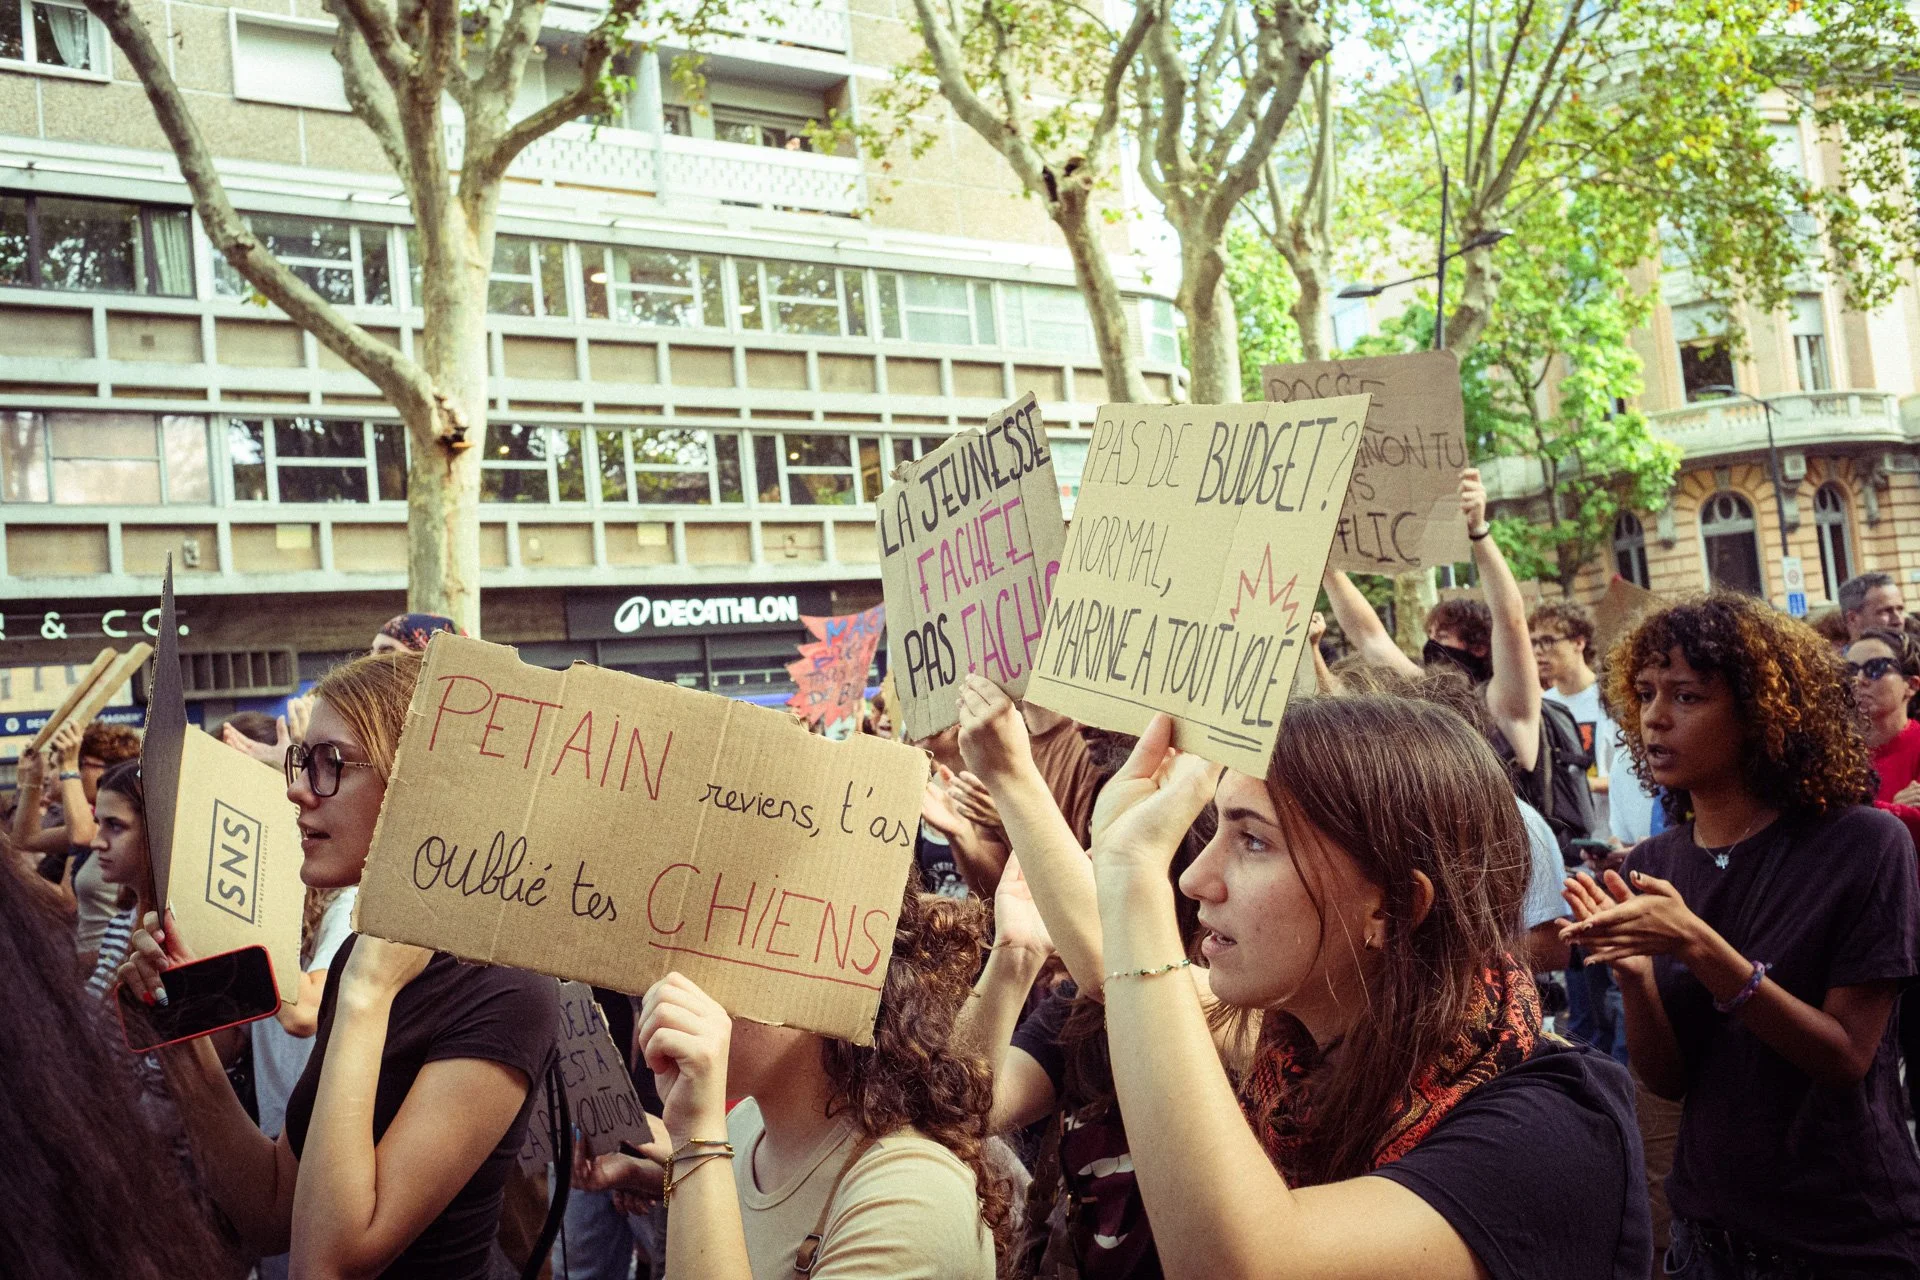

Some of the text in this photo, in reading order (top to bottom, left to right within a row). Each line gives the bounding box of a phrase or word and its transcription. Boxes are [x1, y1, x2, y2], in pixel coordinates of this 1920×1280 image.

[880, 400, 1050, 558] LA JEUNESSE
[1088, 419, 1147, 487] PAS
[1147, 422, 1193, 488] DE
[916, 496, 1034, 614] FACHÉE
[1067, 515, 1173, 598] NORMAL,
[1336, 511, 1421, 567] FLIC
[41, 611, 68, 640] &
[652, 595, 799, 628] DECATHLON
[904, 612, 956, 698] PAS
[1038, 596, 1142, 683] MARINE
[1131, 613, 1158, 696] A
[1160, 616, 1235, 708] TOUT
[698, 782, 820, 838] reviens,
[841, 780, 911, 848] t'as
[217, 816, 251, 908] SNS
[572, 860, 618, 921] tes
